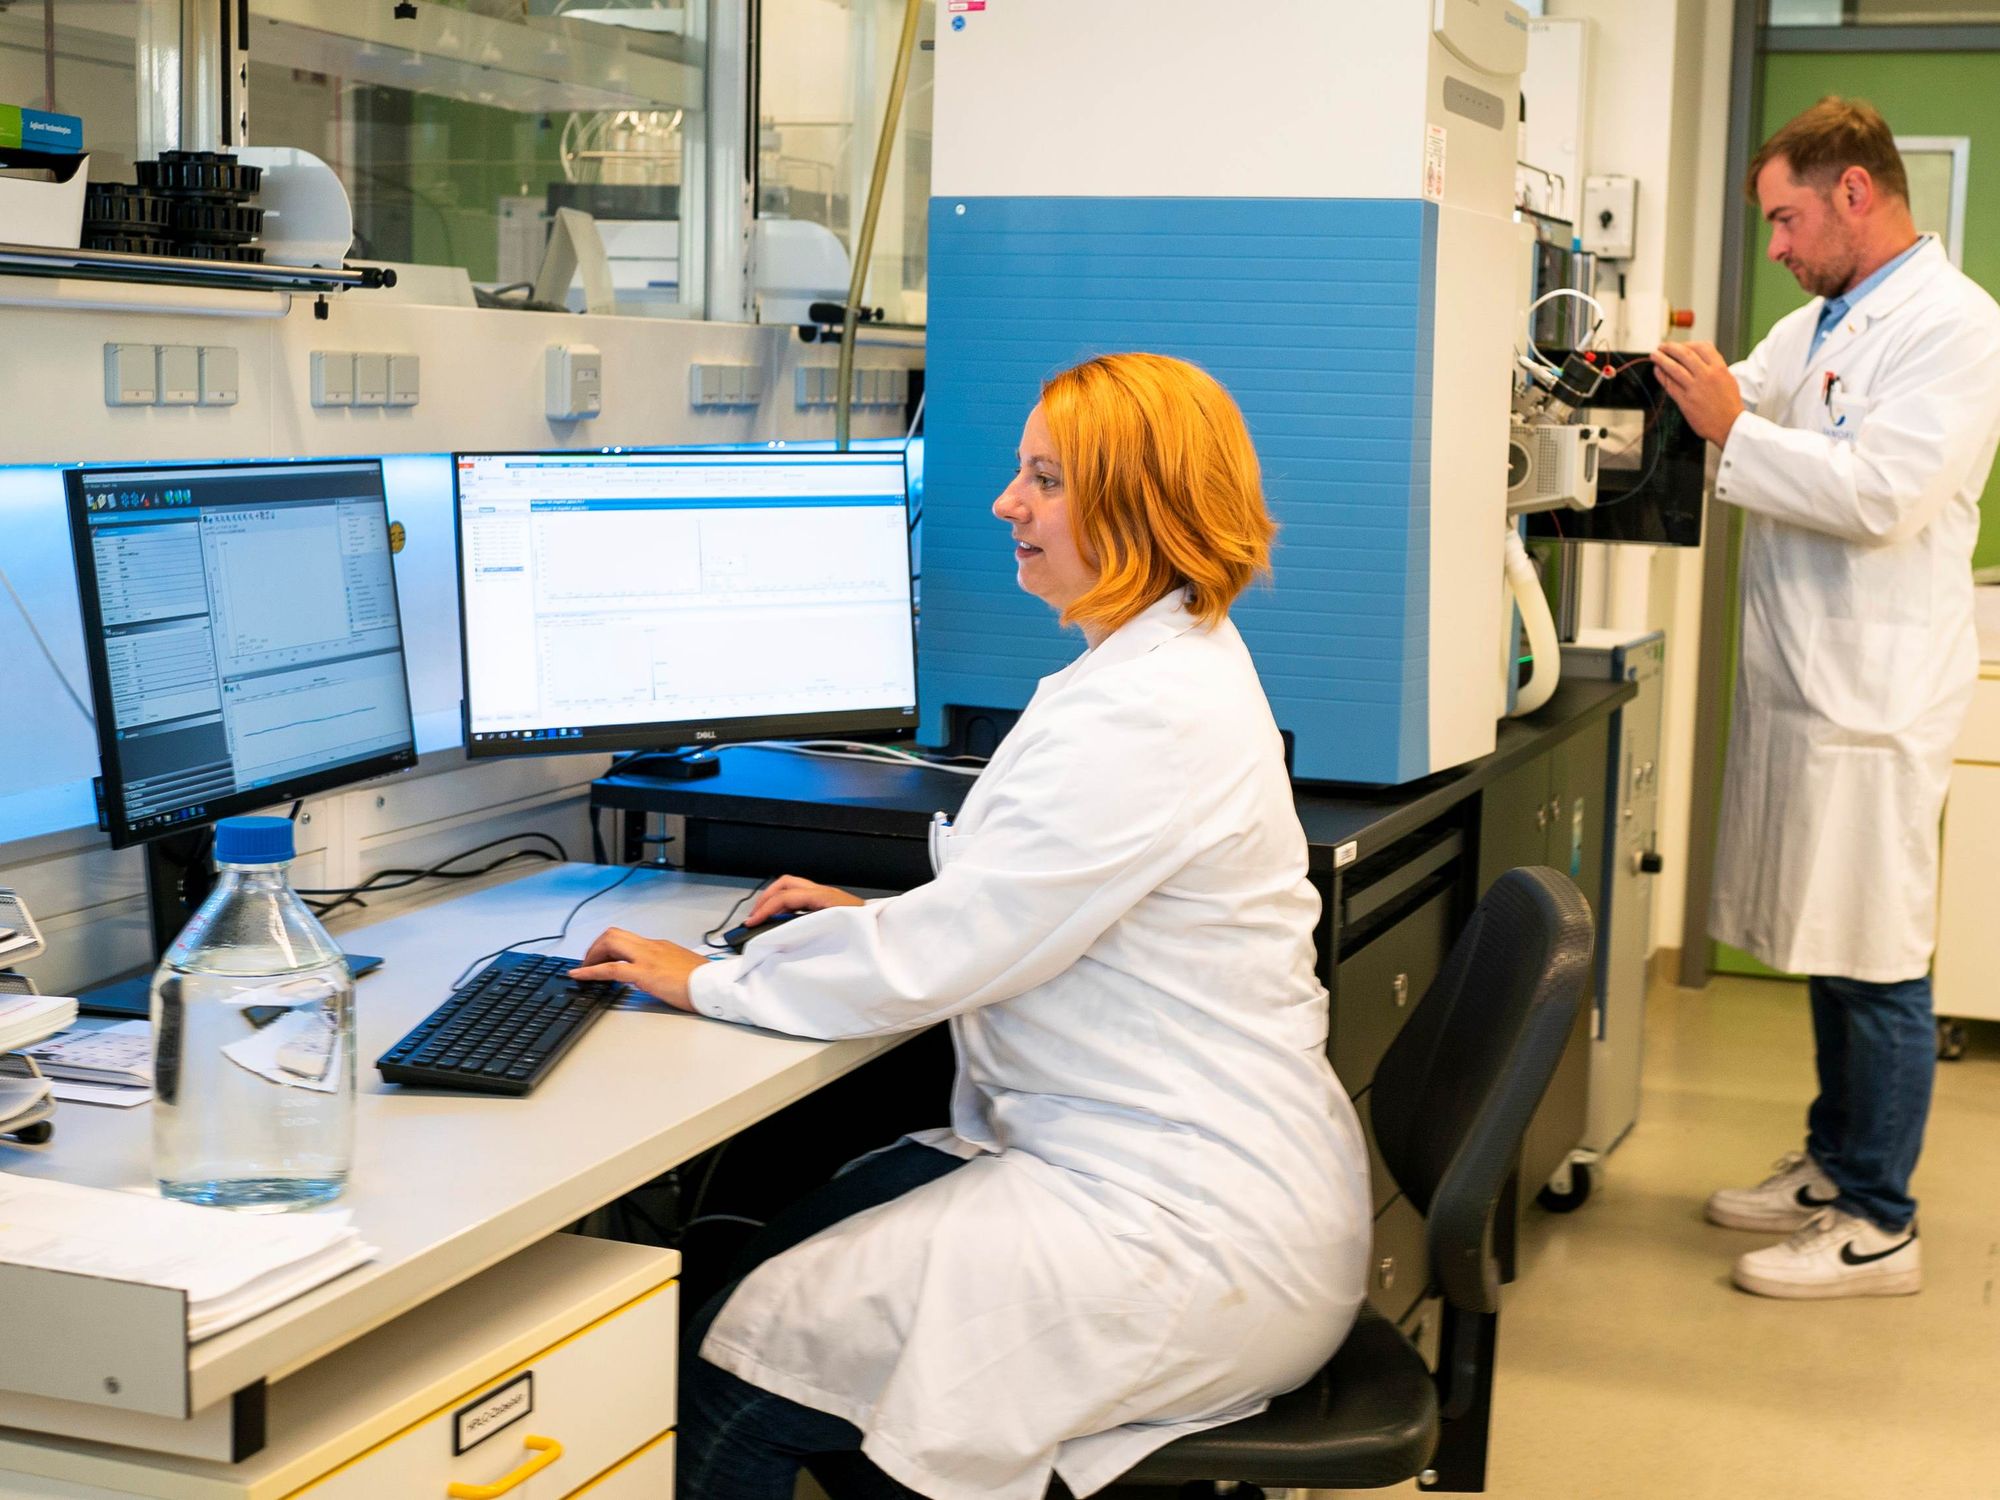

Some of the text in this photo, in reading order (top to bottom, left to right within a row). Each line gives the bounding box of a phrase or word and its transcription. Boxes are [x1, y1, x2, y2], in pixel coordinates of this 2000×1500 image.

[30, 121, 72, 135] Agilent Technologies
[696, 731, 717, 740] DELL
